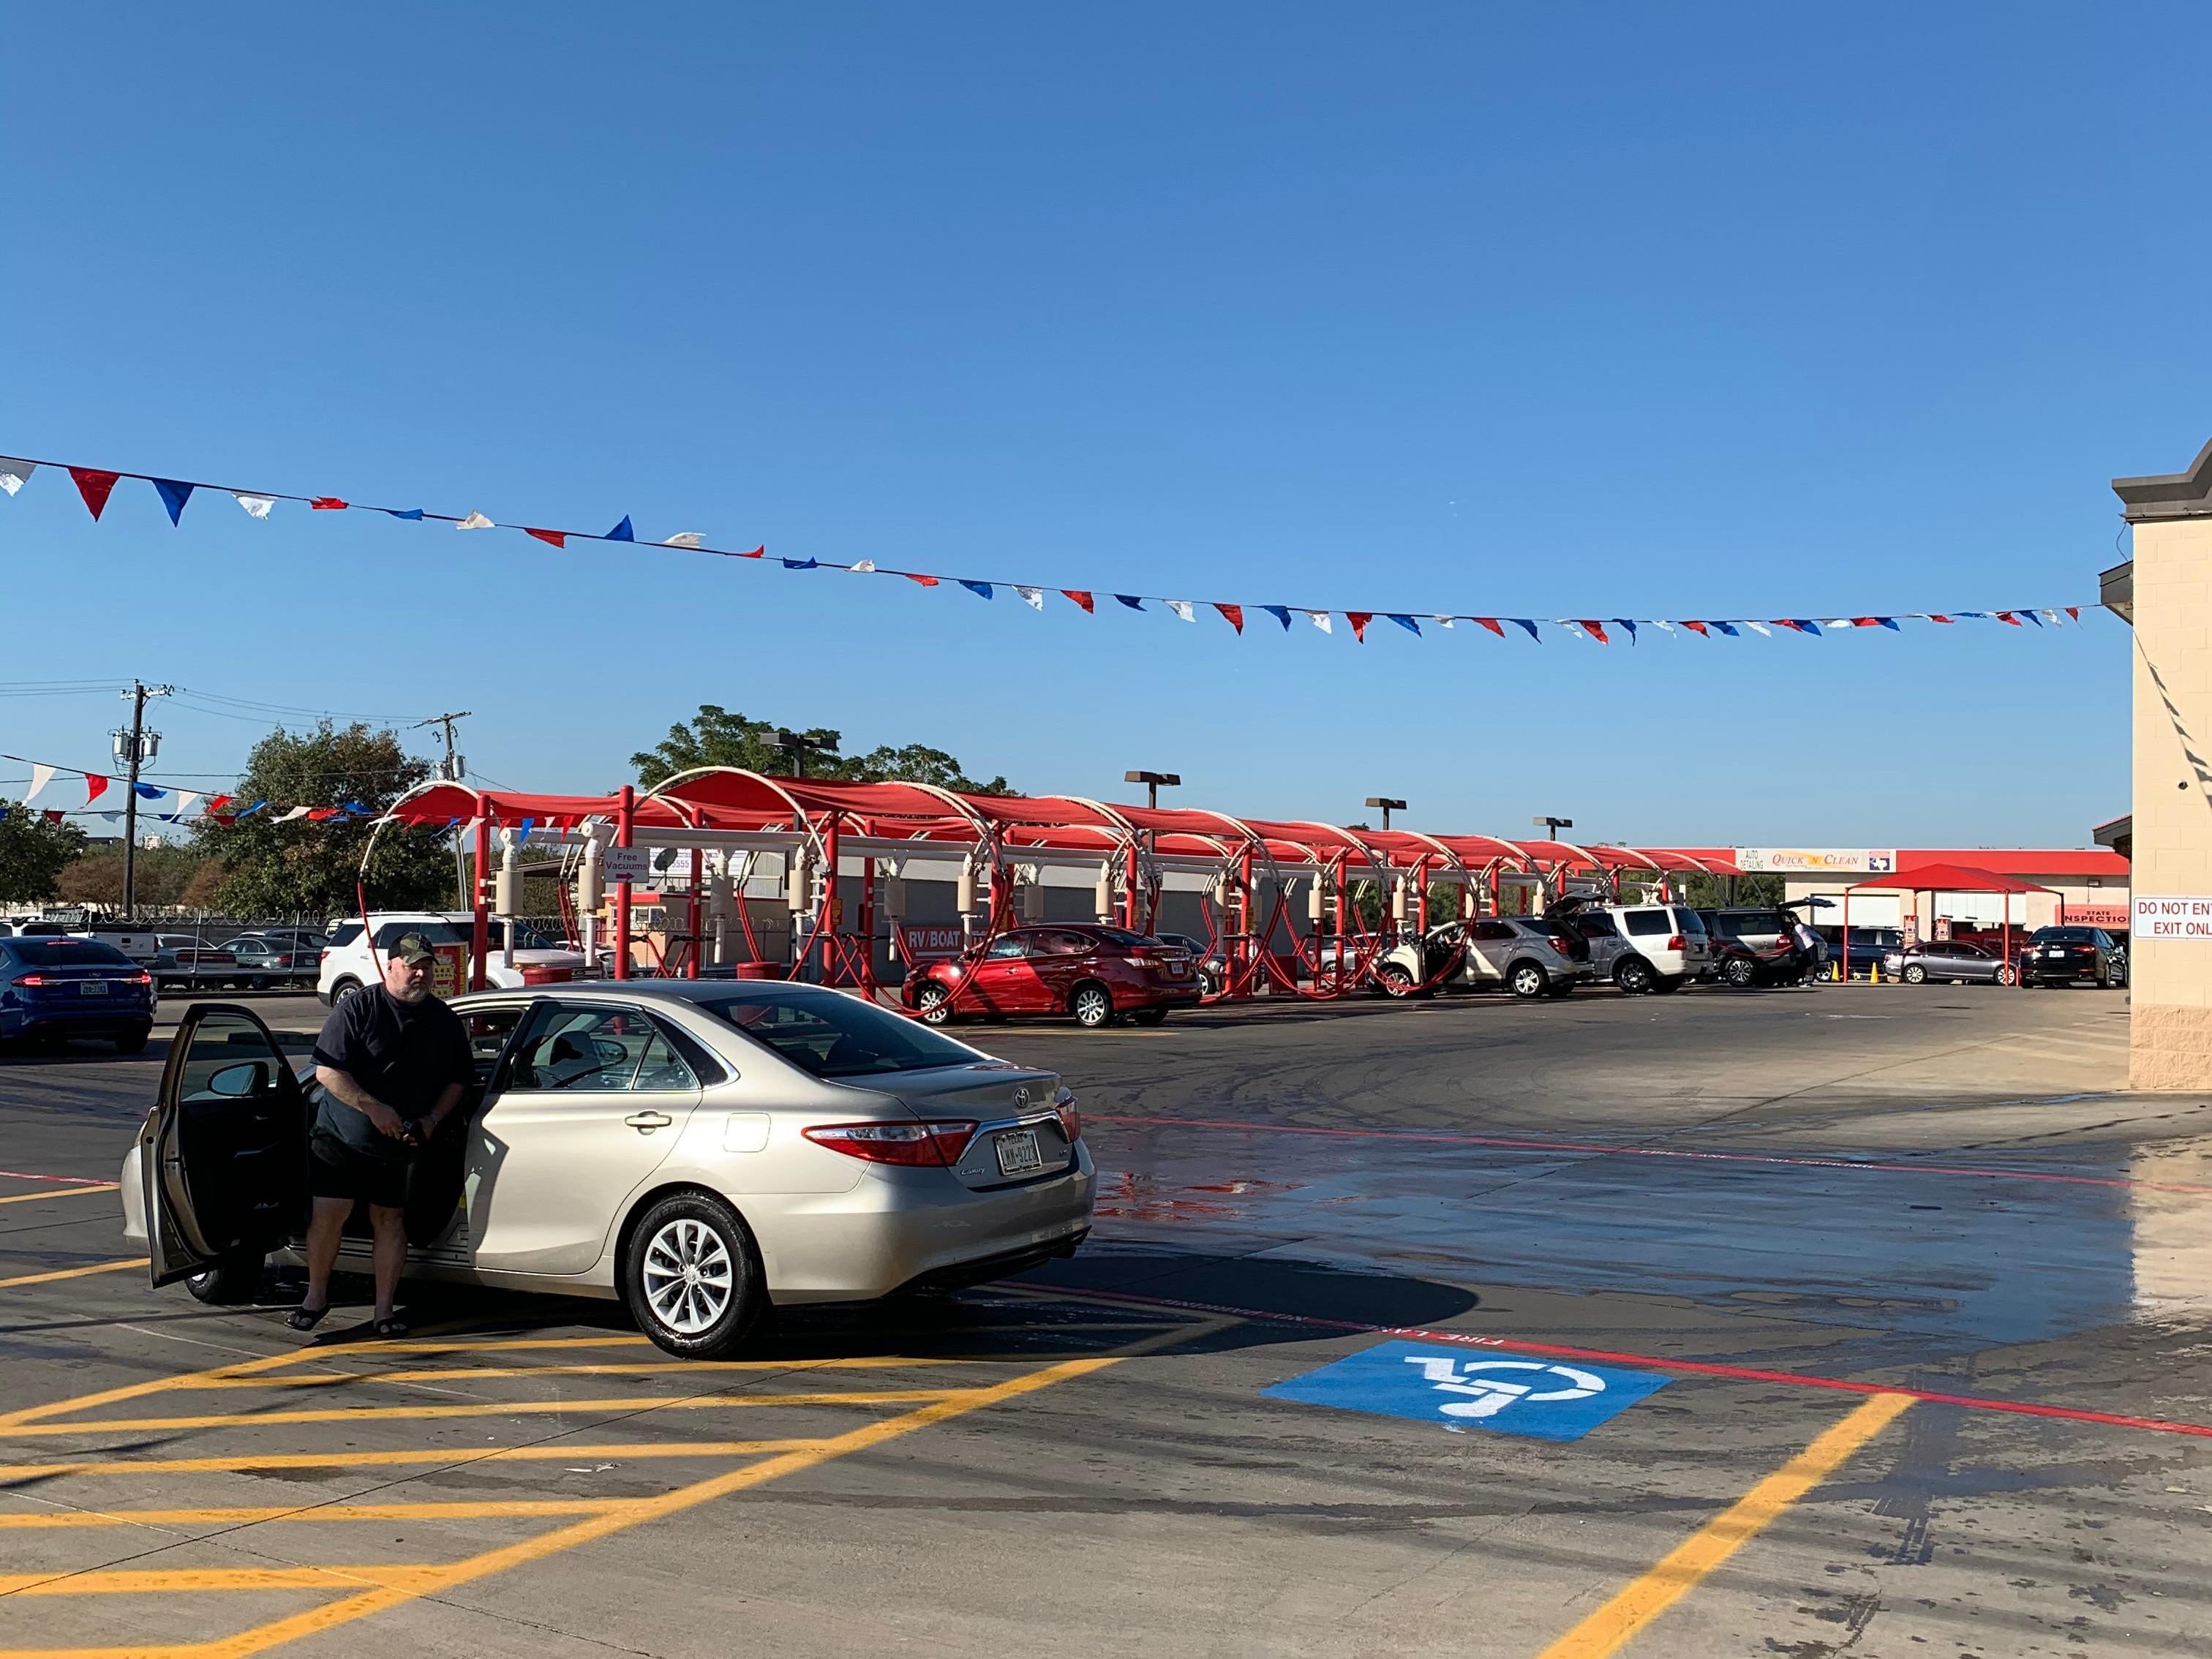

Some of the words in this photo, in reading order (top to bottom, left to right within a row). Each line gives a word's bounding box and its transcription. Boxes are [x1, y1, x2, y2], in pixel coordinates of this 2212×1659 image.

[617, 853, 638, 861] Free
[1745, 851, 1758, 859] AUTO
[606, 862, 647, 870] Vacuums
[1740, 860, 1764, 870] DETAILING
[2139, 902, 2157, 914] DO
[2162, 902, 2189, 914] NOT
[2193, 903, 2212, 915] EN
[2154, 922, 2182, 934] EXIT
[908, 930, 961, 947] RV/BOAT
[1439, 1333, 1505, 1345] FIRE
